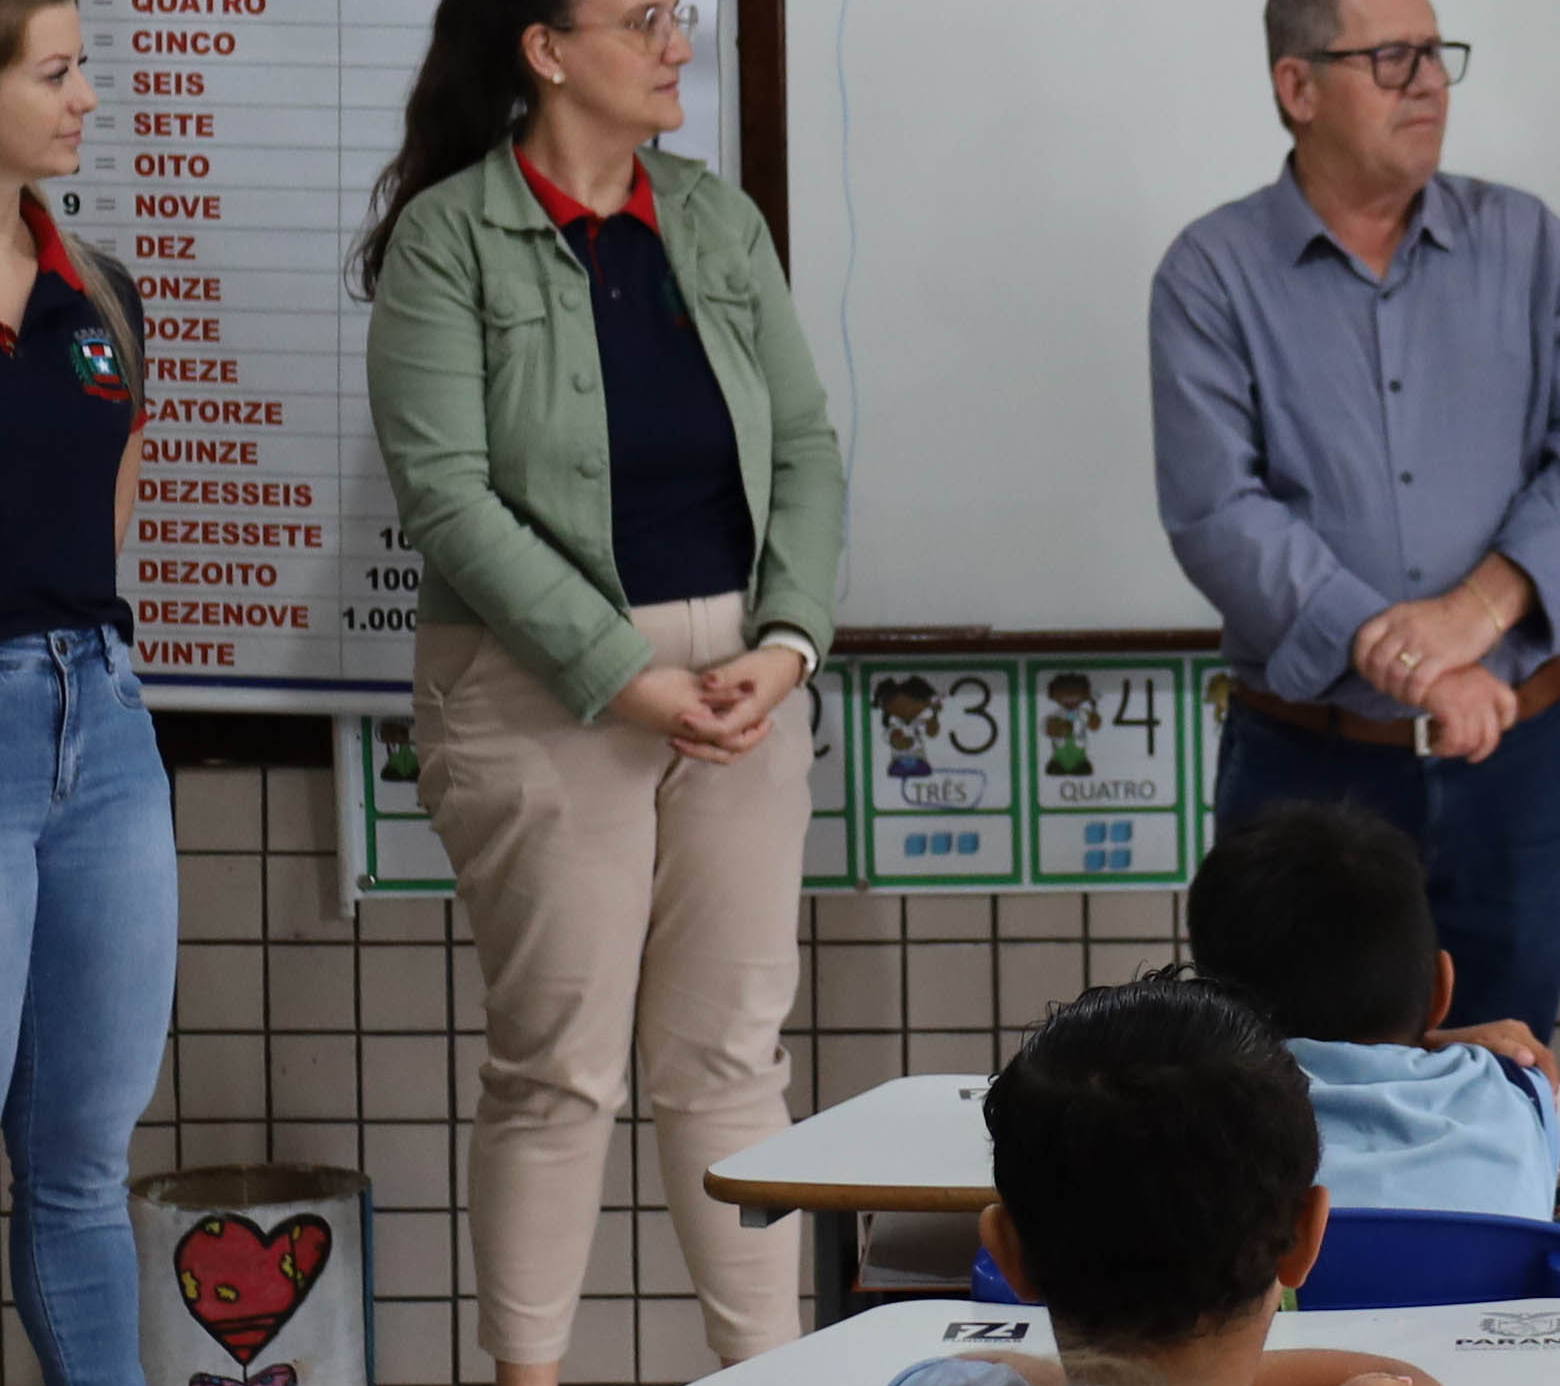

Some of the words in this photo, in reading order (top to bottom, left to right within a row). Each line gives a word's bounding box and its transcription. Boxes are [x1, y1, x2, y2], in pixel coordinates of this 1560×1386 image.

[132, 31, 236, 55] CINCO
[133, 73, 205, 96] SEIS
[133, 114, 214, 137] SETE
[134, 154, 210, 177] OITO
[63, 193, 80, 216] 9
[135, 196, 220, 220] NOVE
[136, 236, 196, 259] DEZ
[139, 277, 221, 301] ONZE
[144, 318, 220, 341] DOZE
[144, 359, 237, 383] TREZE
[146, 399, 283, 425] CATORZE
[141, 439, 258, 464] QUINZE
[139, 480, 312, 507] DEZESSEIS
[139, 520, 322, 548] DEZESSETE
[139, 560, 277, 586] DEZOITO
[139, 601, 309, 628] DEZENOVE
[139, 641, 235, 665] VINTE
[949, 676, 998, 755] 3
[1113, 678, 1161, 757] 4
[910, 777, 968, 803] TRÊS
[1060, 780, 1157, 802] QUATRO
